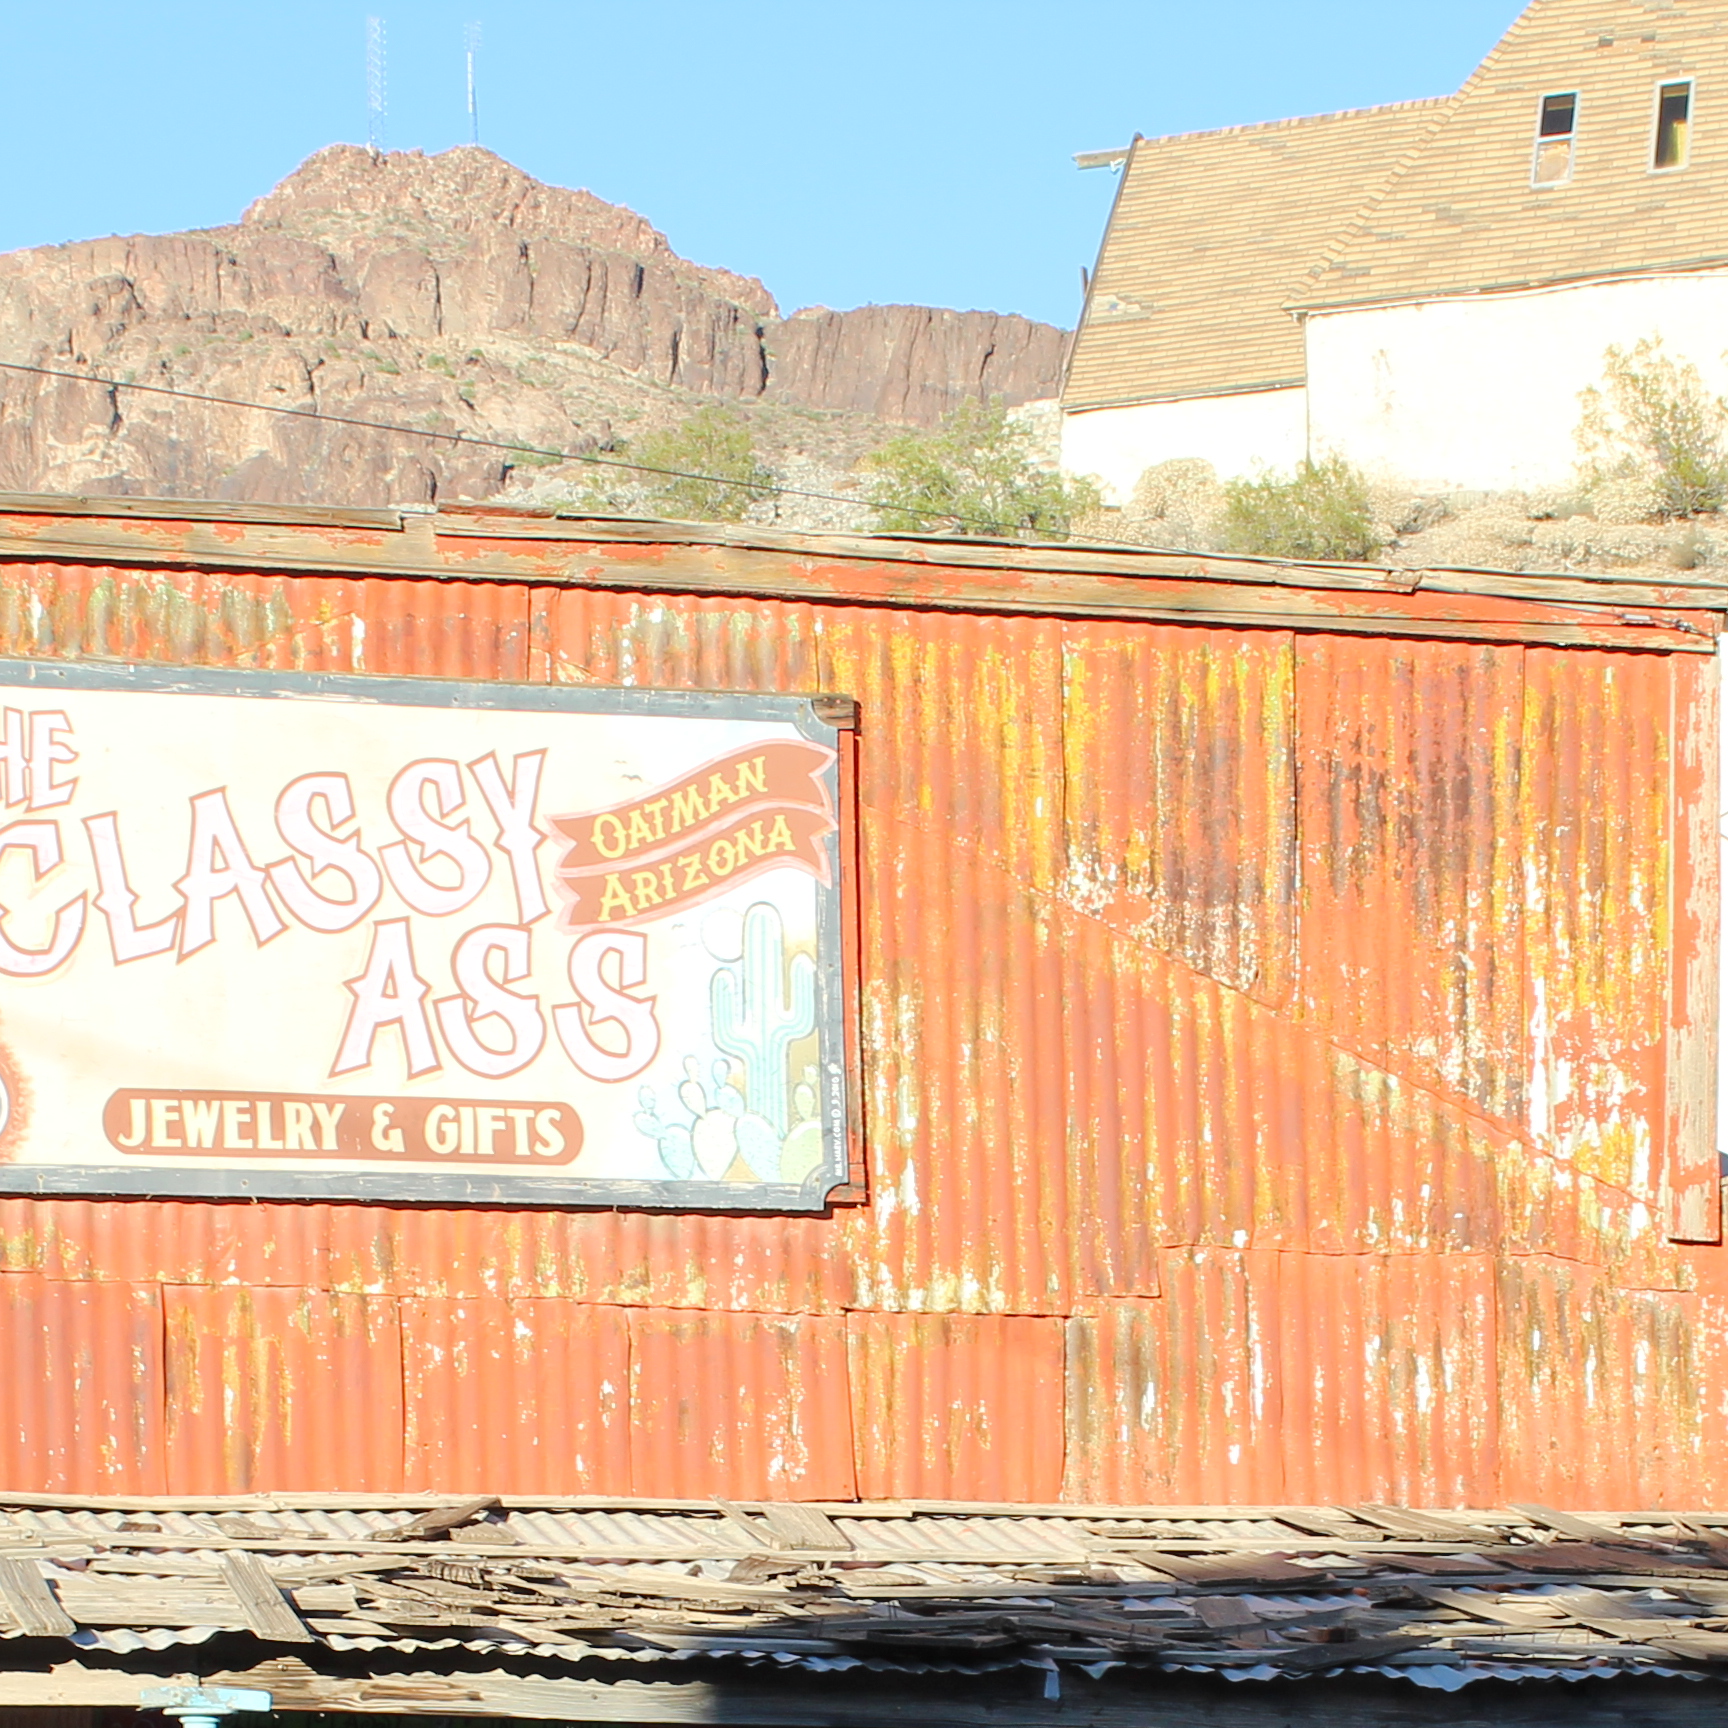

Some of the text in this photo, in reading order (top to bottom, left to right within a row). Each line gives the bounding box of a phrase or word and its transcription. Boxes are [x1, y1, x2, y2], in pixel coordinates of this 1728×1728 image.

[590, 755, 768, 859] OATMAN
[597, 814, 796, 922] ARIZONA
[327, 917, 662, 1083] ASS
[118, 1097, 566, 1157] JEWELRY & GIFTS
